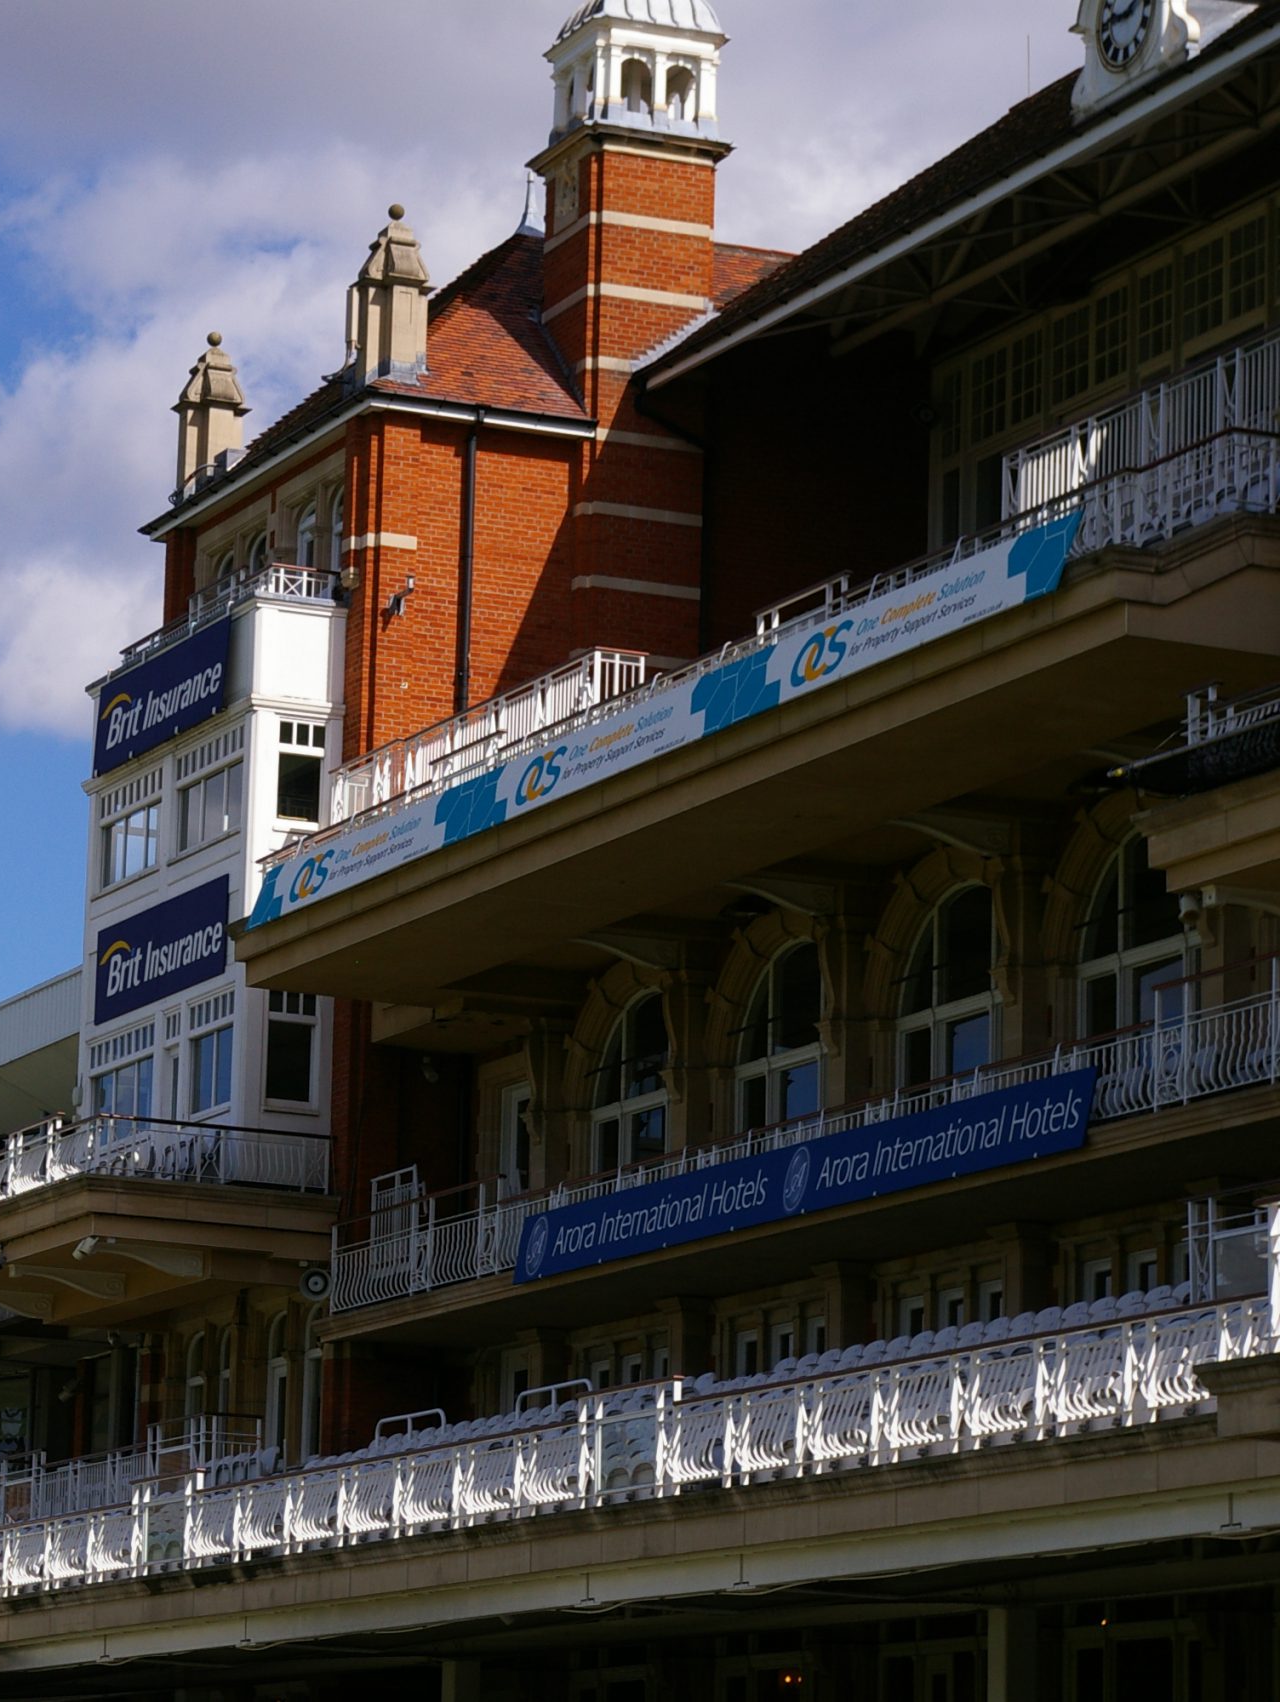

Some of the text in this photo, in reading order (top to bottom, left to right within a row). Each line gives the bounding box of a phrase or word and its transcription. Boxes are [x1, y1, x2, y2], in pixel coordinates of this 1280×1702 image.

[848, 593, 977, 657] for Property Support Services
[856, 570, 986, 636] One Complete Solution
[790, 619, 855, 688] OCS
[106, 662, 222, 750] Brit Insurance
[569, 706, 674, 761] One Complete Solution
[515, 745, 568, 806] OCS
[573, 755, 605, 778] Property
[605, 740, 635, 763] Support
[634, 728, 666, 751] Services
[351, 831, 390, 857] Complete
[389, 817, 422, 840] Solution
[289, 849, 335, 903] OCS
[106, 921, 223, 997] Brit Insurance
[816, 1088, 1082, 1191] Arora International Hotels
[552, 1168, 769, 1257] Arora International Hotels
